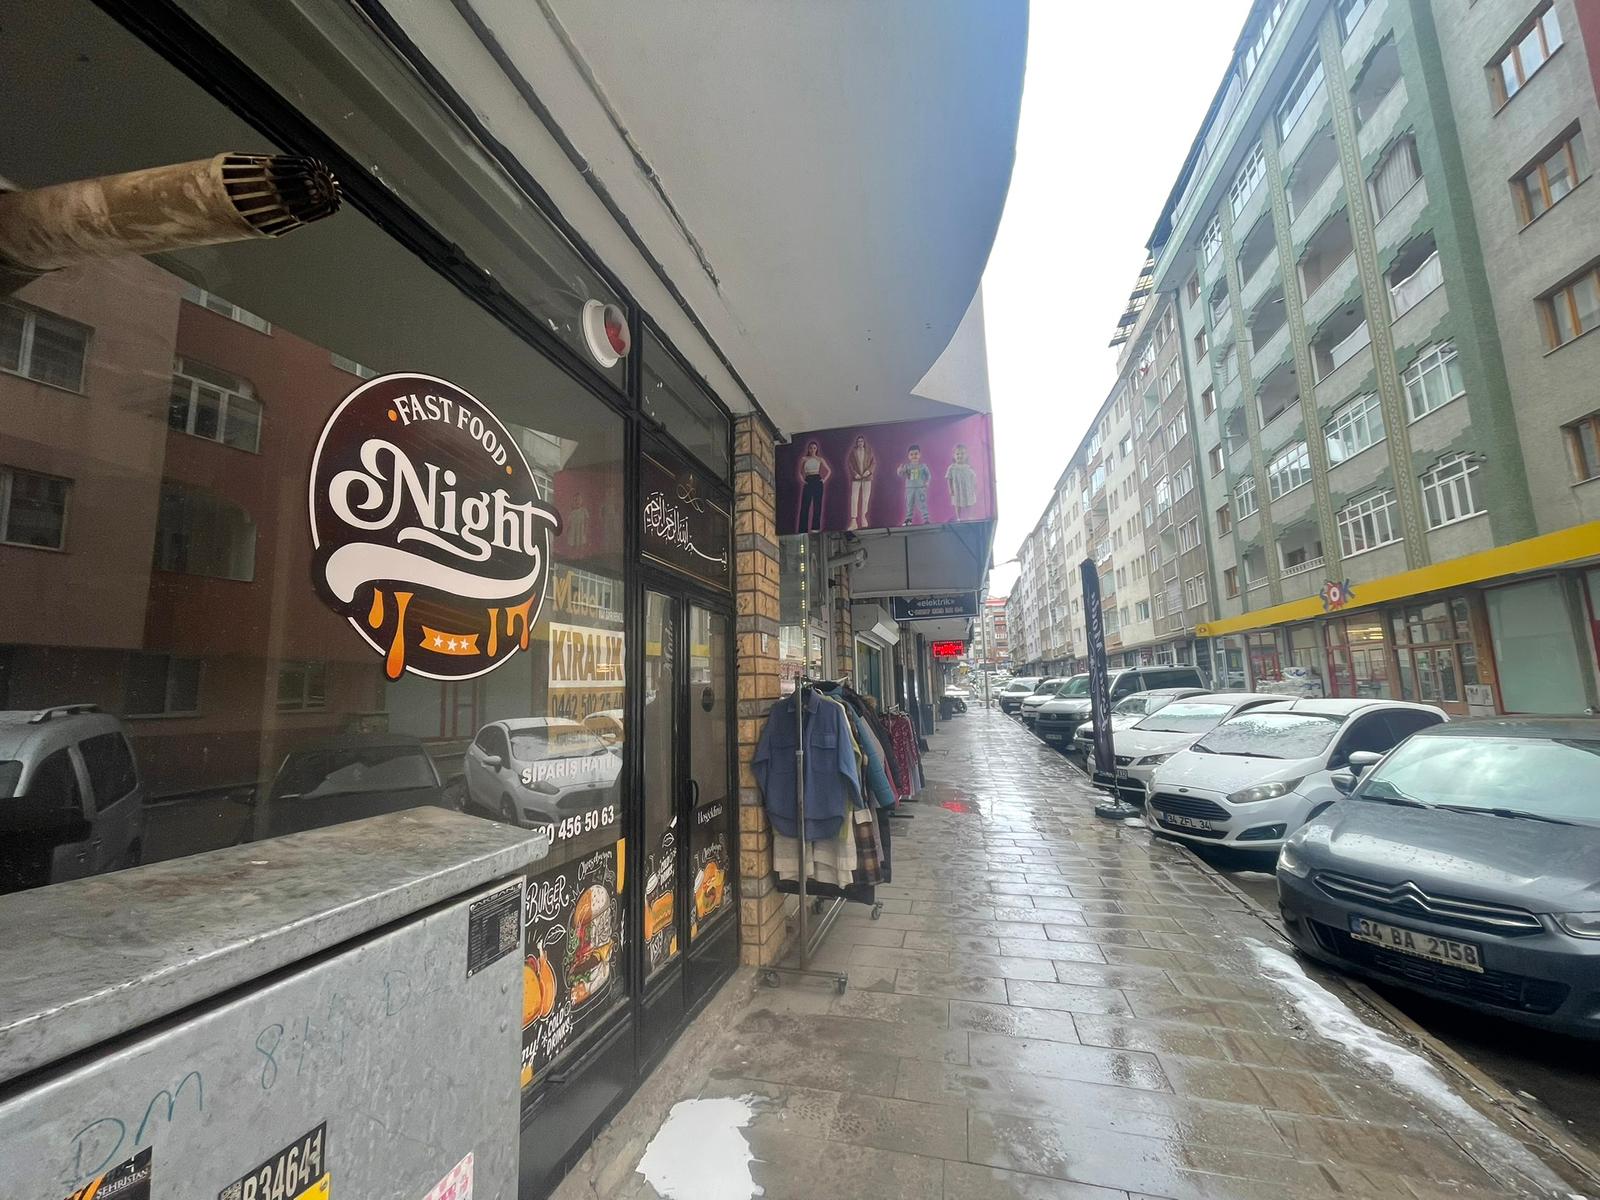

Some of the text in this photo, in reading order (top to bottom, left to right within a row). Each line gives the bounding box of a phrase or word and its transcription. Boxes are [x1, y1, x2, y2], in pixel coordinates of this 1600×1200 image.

[393, 394, 507, 467] FAST FOOD
[328, 438, 558, 580] Night
[558, 815, 581, 840] 456
[584, 810, 599, 832] 50
[601, 805, 615, 826] 63
[1360, 920, 1478, 965] 34 BA 2158
